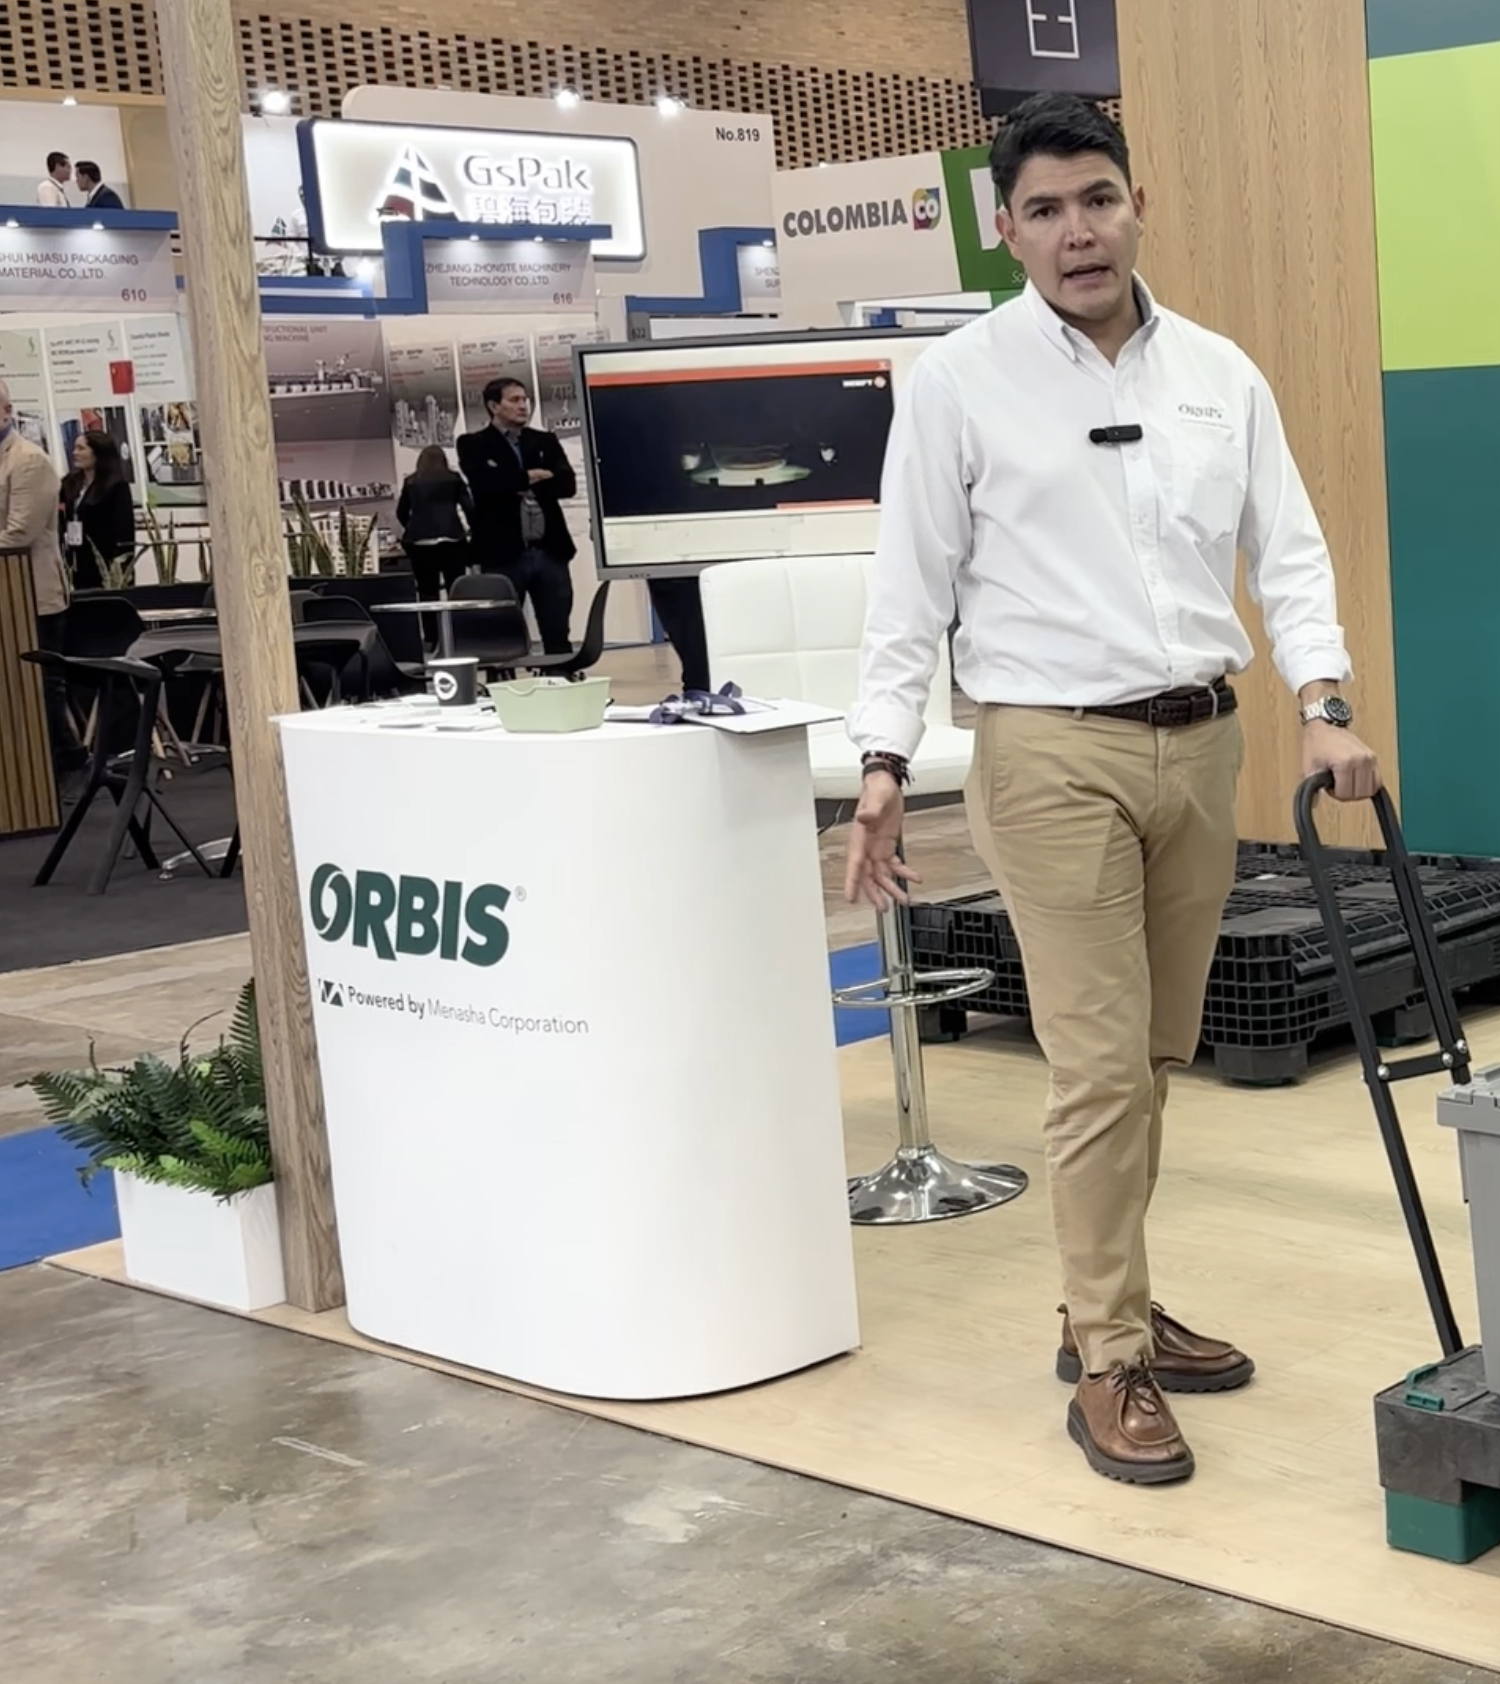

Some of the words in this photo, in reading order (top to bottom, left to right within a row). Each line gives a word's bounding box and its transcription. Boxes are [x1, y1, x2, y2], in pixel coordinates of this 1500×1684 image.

[716, 127, 760, 142] No.819
[463, 155, 589, 190] GsPak
[783, 199, 908, 238] COLOMBIA
[0, 252, 23, 264] HUI
[27, 252, 68, 264] HUASU
[71, 253, 139, 266] PACKAGING
[426, 262, 471, 273] ZHEJIANG
[474, 262, 517, 273] ZHONGTE
[519, 263, 571, 273] MACHINERY
[450, 276, 512, 287] TECHNOLOGY
[121, 289, 147, 301] 610
[553, 293, 573, 304] 616
[309, 862, 512, 968] ORBIS
[348, 985, 405, 1013] Powered
[408, 995, 426, 1020] by
[428, 998, 486, 1026] Menasha
[488, 1007, 590, 1035] Corporation
